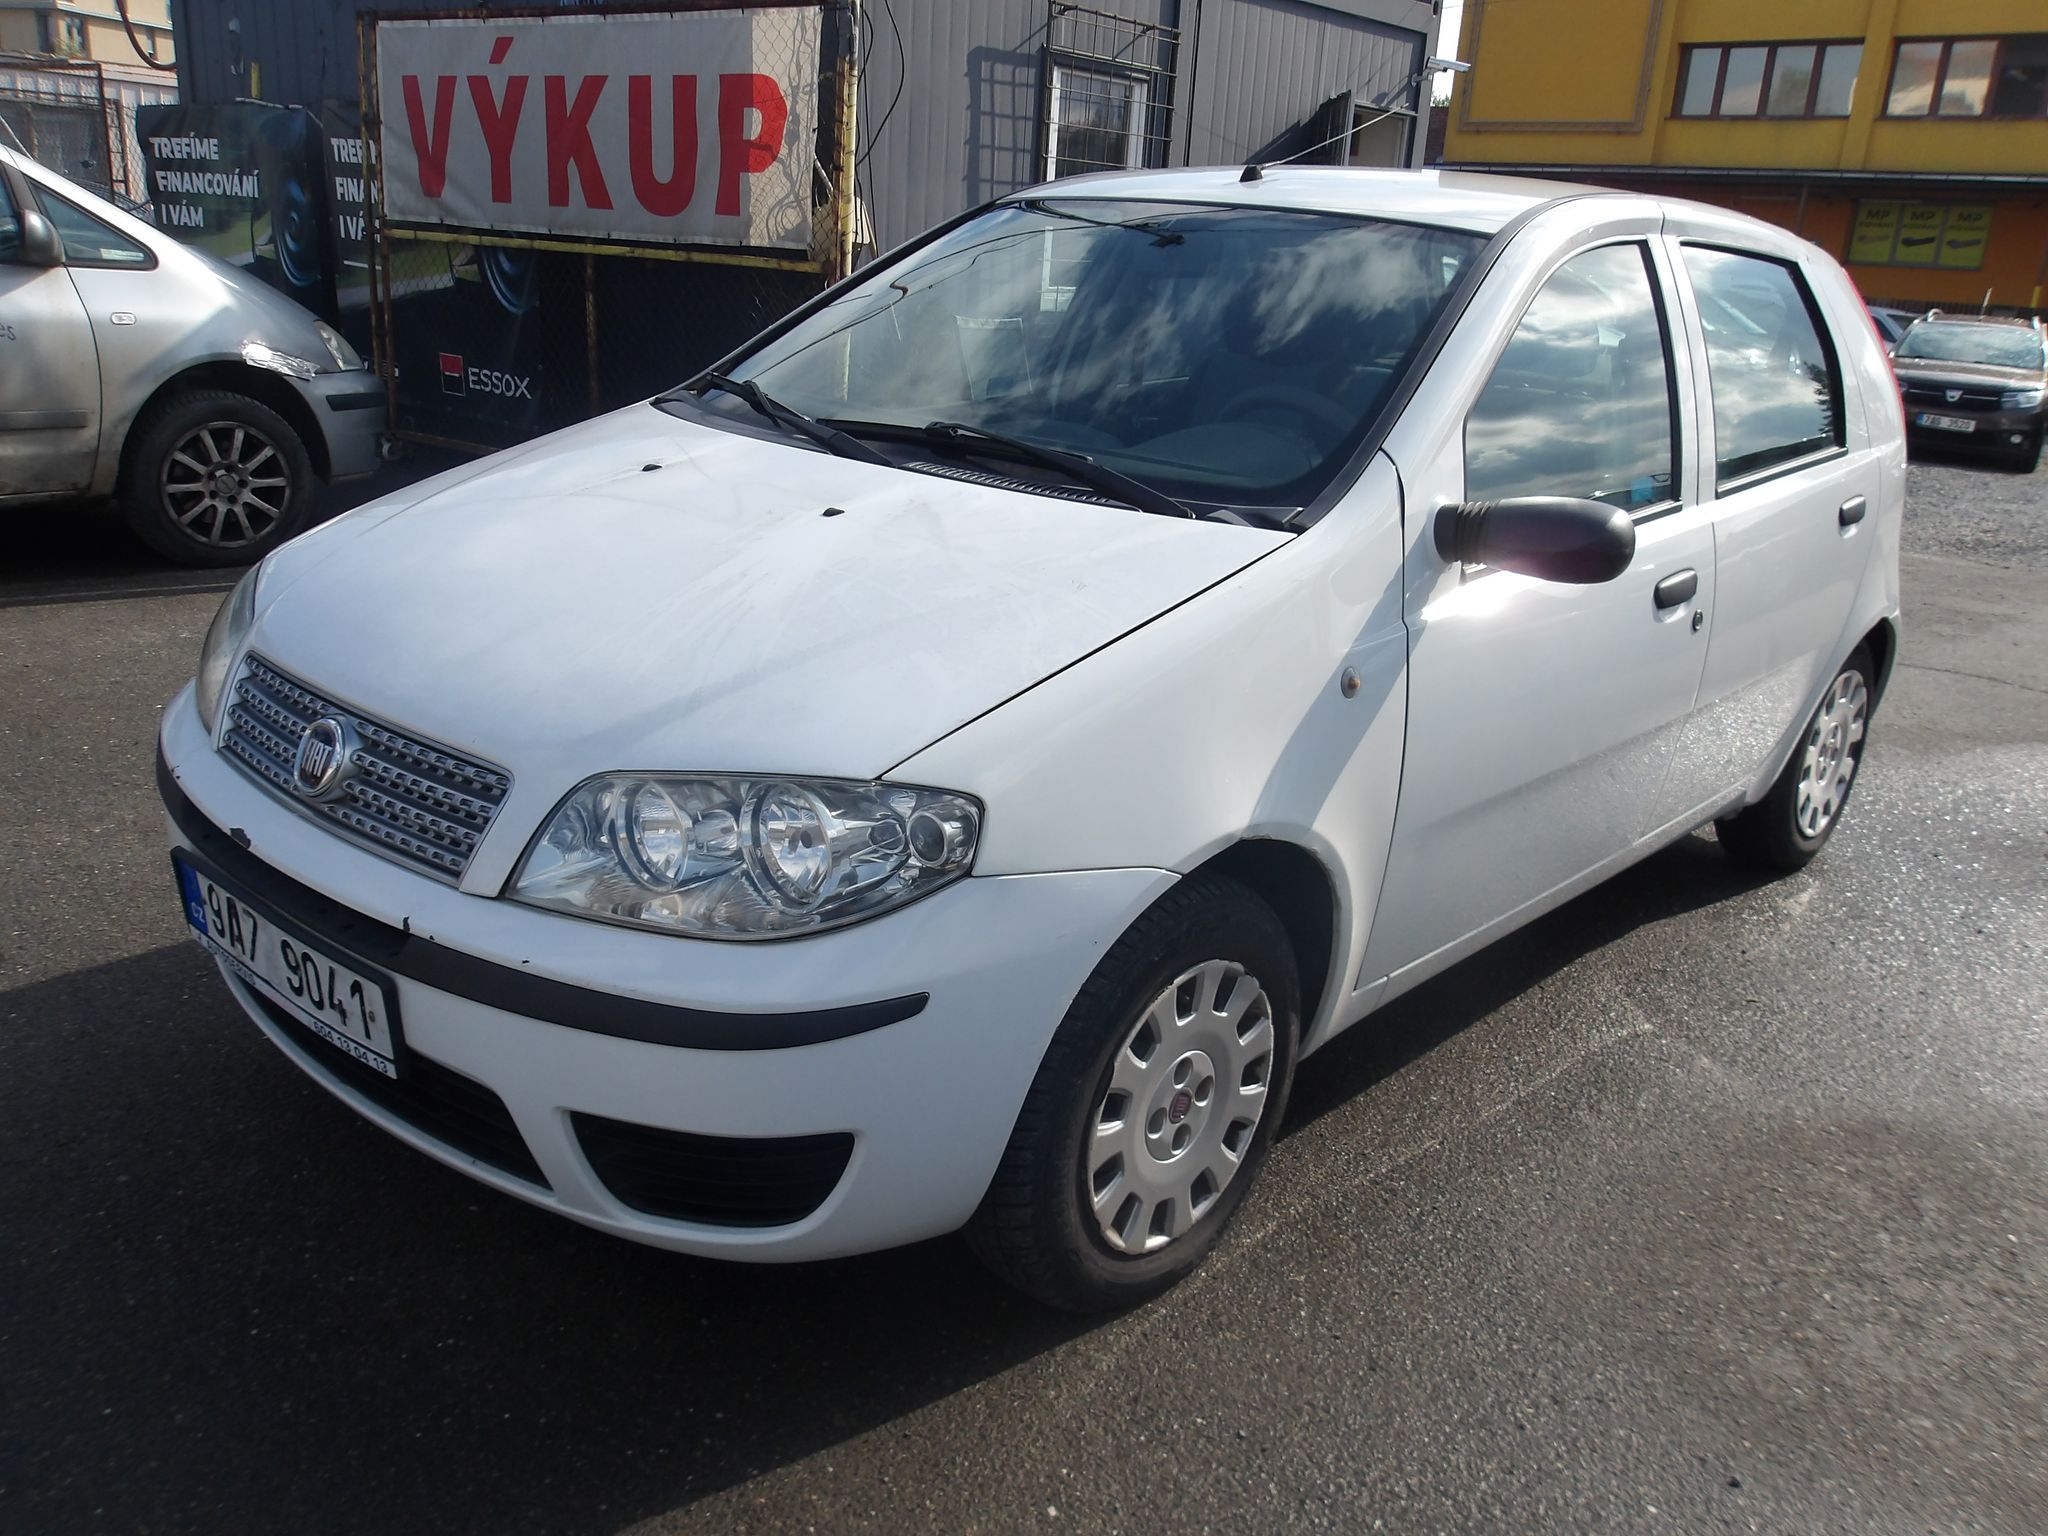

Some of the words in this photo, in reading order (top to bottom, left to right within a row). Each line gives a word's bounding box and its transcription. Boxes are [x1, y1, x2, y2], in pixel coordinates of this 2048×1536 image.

[402, 36, 788, 218] VÝKUP
[150, 132, 219, 161] TREFÍME
[156, 168, 259, 198] FINANCOVÁNÍ
[162, 204, 167, 225] I
[169, 200, 204, 228] VÁM
[340, 214, 346, 239] I
[467, 367, 532, 399] ESSOX
[301, 737, 333, 777] FIAT
[207, 882, 258, 962] 9A7
[280, 938, 372, 1041] 9041
